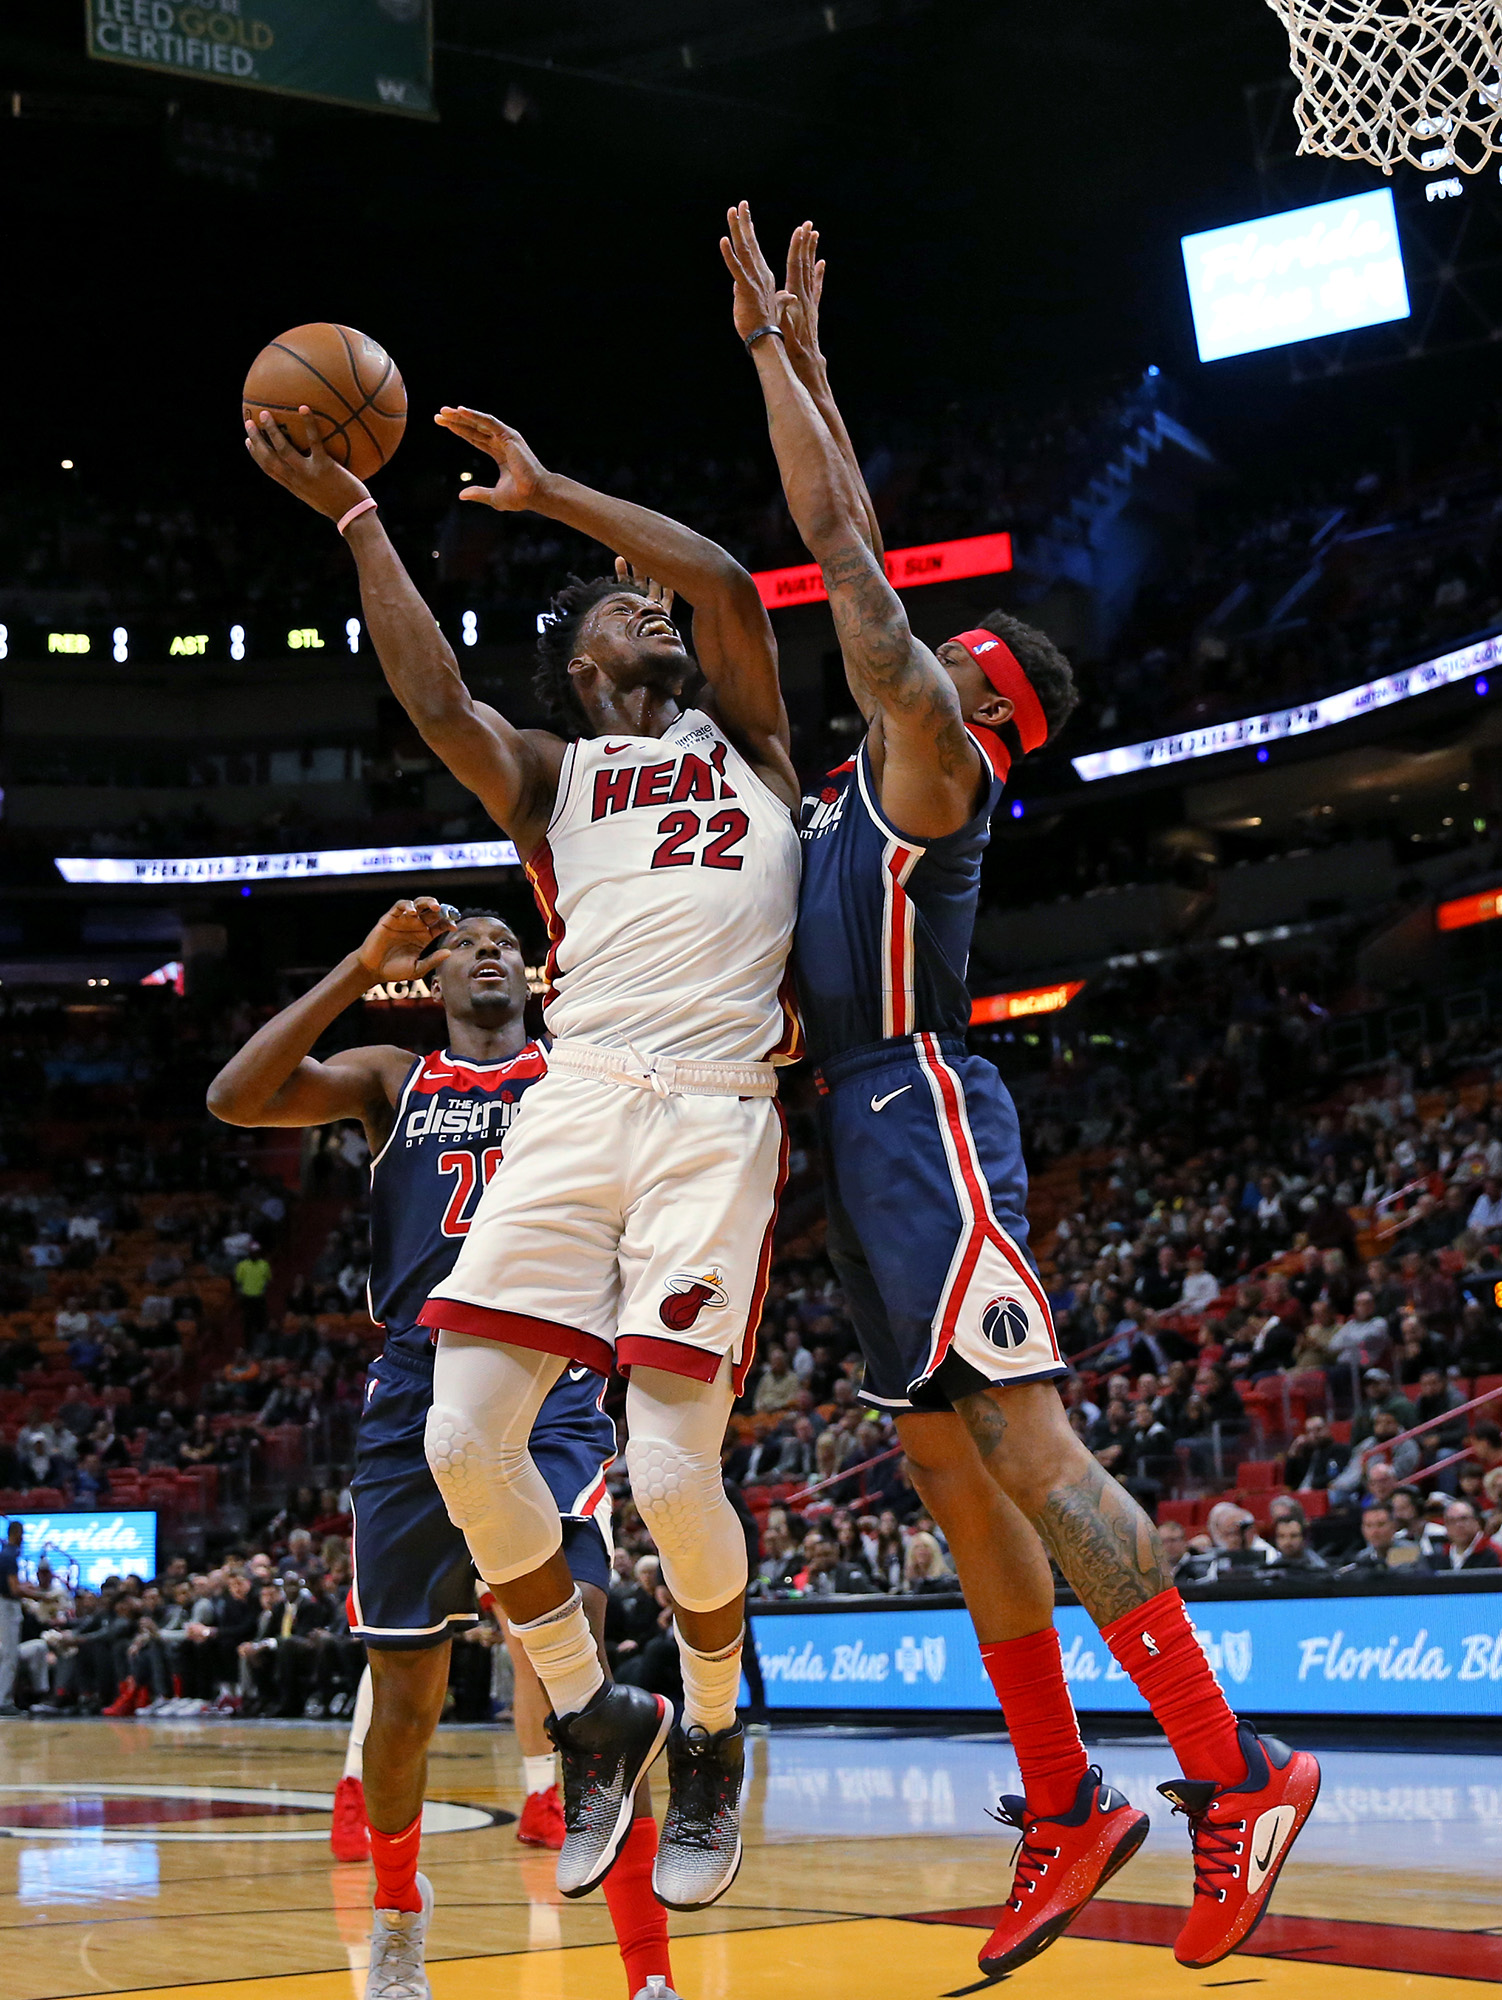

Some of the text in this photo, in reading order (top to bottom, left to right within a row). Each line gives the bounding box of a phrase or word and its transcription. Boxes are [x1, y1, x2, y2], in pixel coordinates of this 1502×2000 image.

[98, 0, 174, 30] LEED
[179, 5, 274, 49] GOLD
[48, 633, 90, 653] REB
[169, 635, 209, 656] AST
[287, 628, 325, 649] STL
[650, 807, 750, 871] 22
[448, 1099, 473, 1109] THE
[437, 1146, 504, 1238] 2
[828, 1639, 890, 1682] Blue
[1299, 1628, 1452, 1681] Florida
